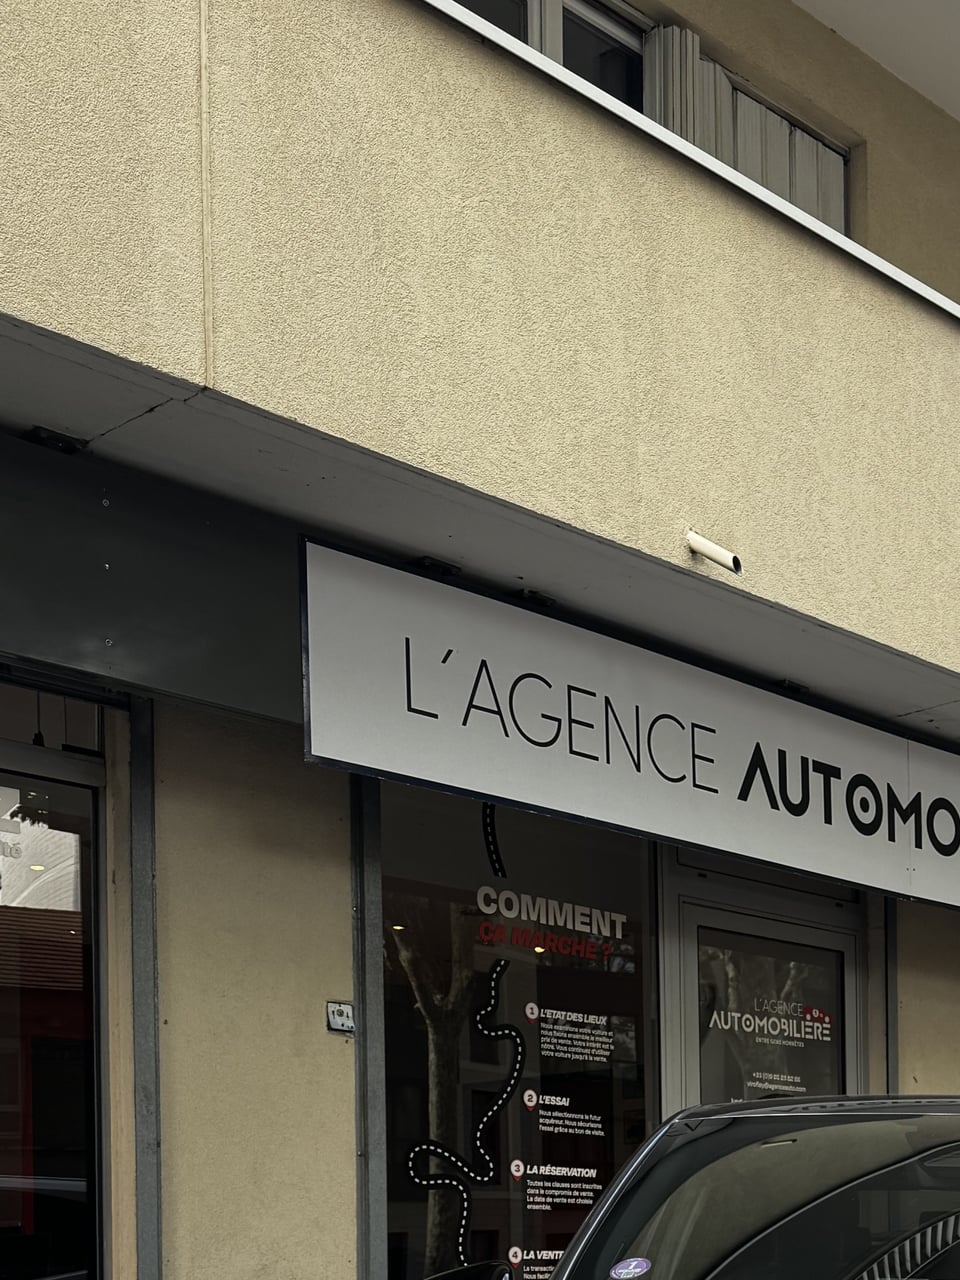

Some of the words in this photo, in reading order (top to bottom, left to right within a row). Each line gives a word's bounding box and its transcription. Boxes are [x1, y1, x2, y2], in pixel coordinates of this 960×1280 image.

[477, 886, 627, 939] COMMENT
[511, 927, 596, 960] MARCHE
[529, 1006, 535, 1015] 1
[540, 1008, 566, 1020] L'ETAT
[566, 1012, 583, 1022] DES
[584, 1014, 608, 1026] LIEUX
[528, 1094, 534, 1102] 2
[539, 1094, 570, 1107] L'ESSAI
[514, 1164, 521, 1172] 3
[526, 1165, 538, 1174] LA
[539, 1164, 597, 1178] RÉSERVATION
[512, 1251, 518, 1259] 4
[523, 1250, 535, 1260] LA
